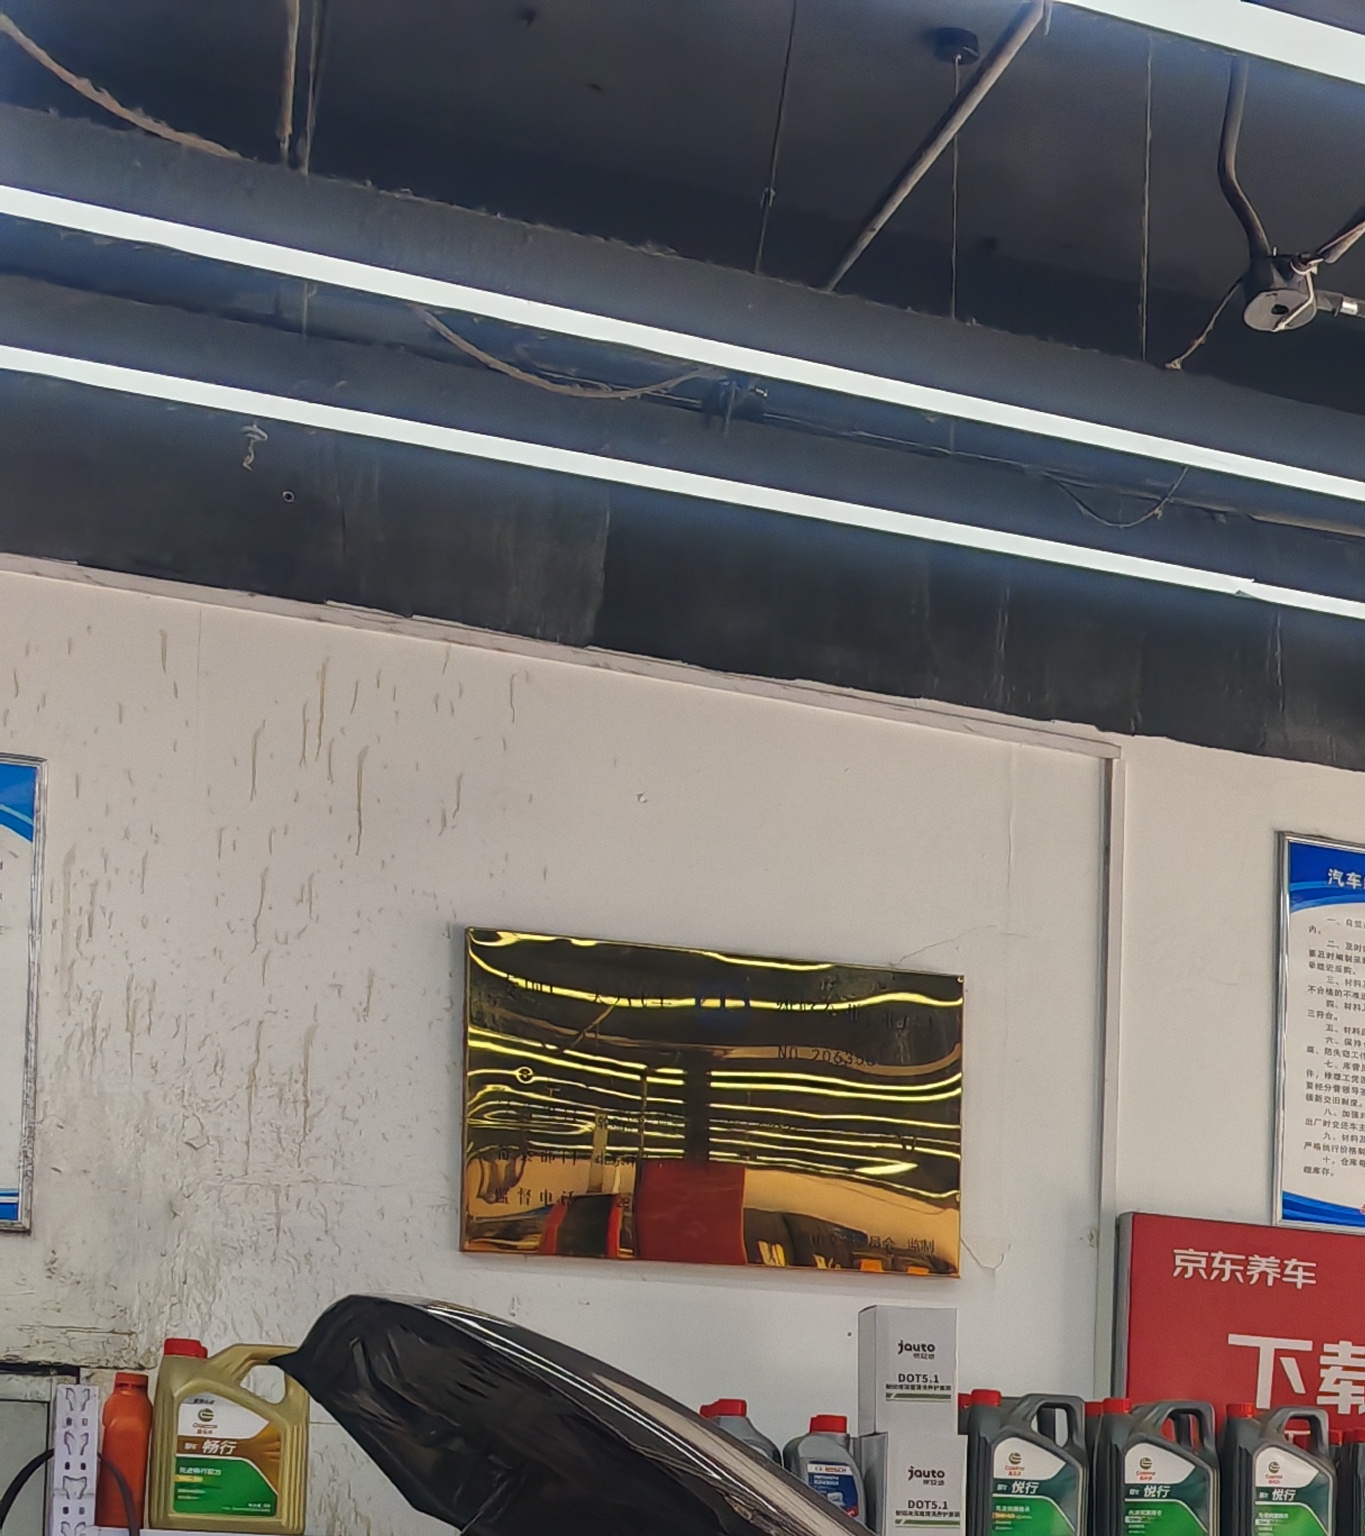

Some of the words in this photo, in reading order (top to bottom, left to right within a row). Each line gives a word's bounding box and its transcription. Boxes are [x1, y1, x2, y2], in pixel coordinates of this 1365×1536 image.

[1172, 1247, 1318, 1290] 京东养车
[898, 1340, 935, 1354] jauto
[898, 1374, 939, 1383] DOT5.1
[202, 1439, 238, 1455] 畅行
[908, 1466, 945, 1480] jauto
[1011, 1481, 1040, 1494] 悦行
[1143, 1485, 1171, 1498] 悦行
[1271, 1489, 1296, 1502] 悦行
[908, 1500, 948, 1509] DOT5.1
